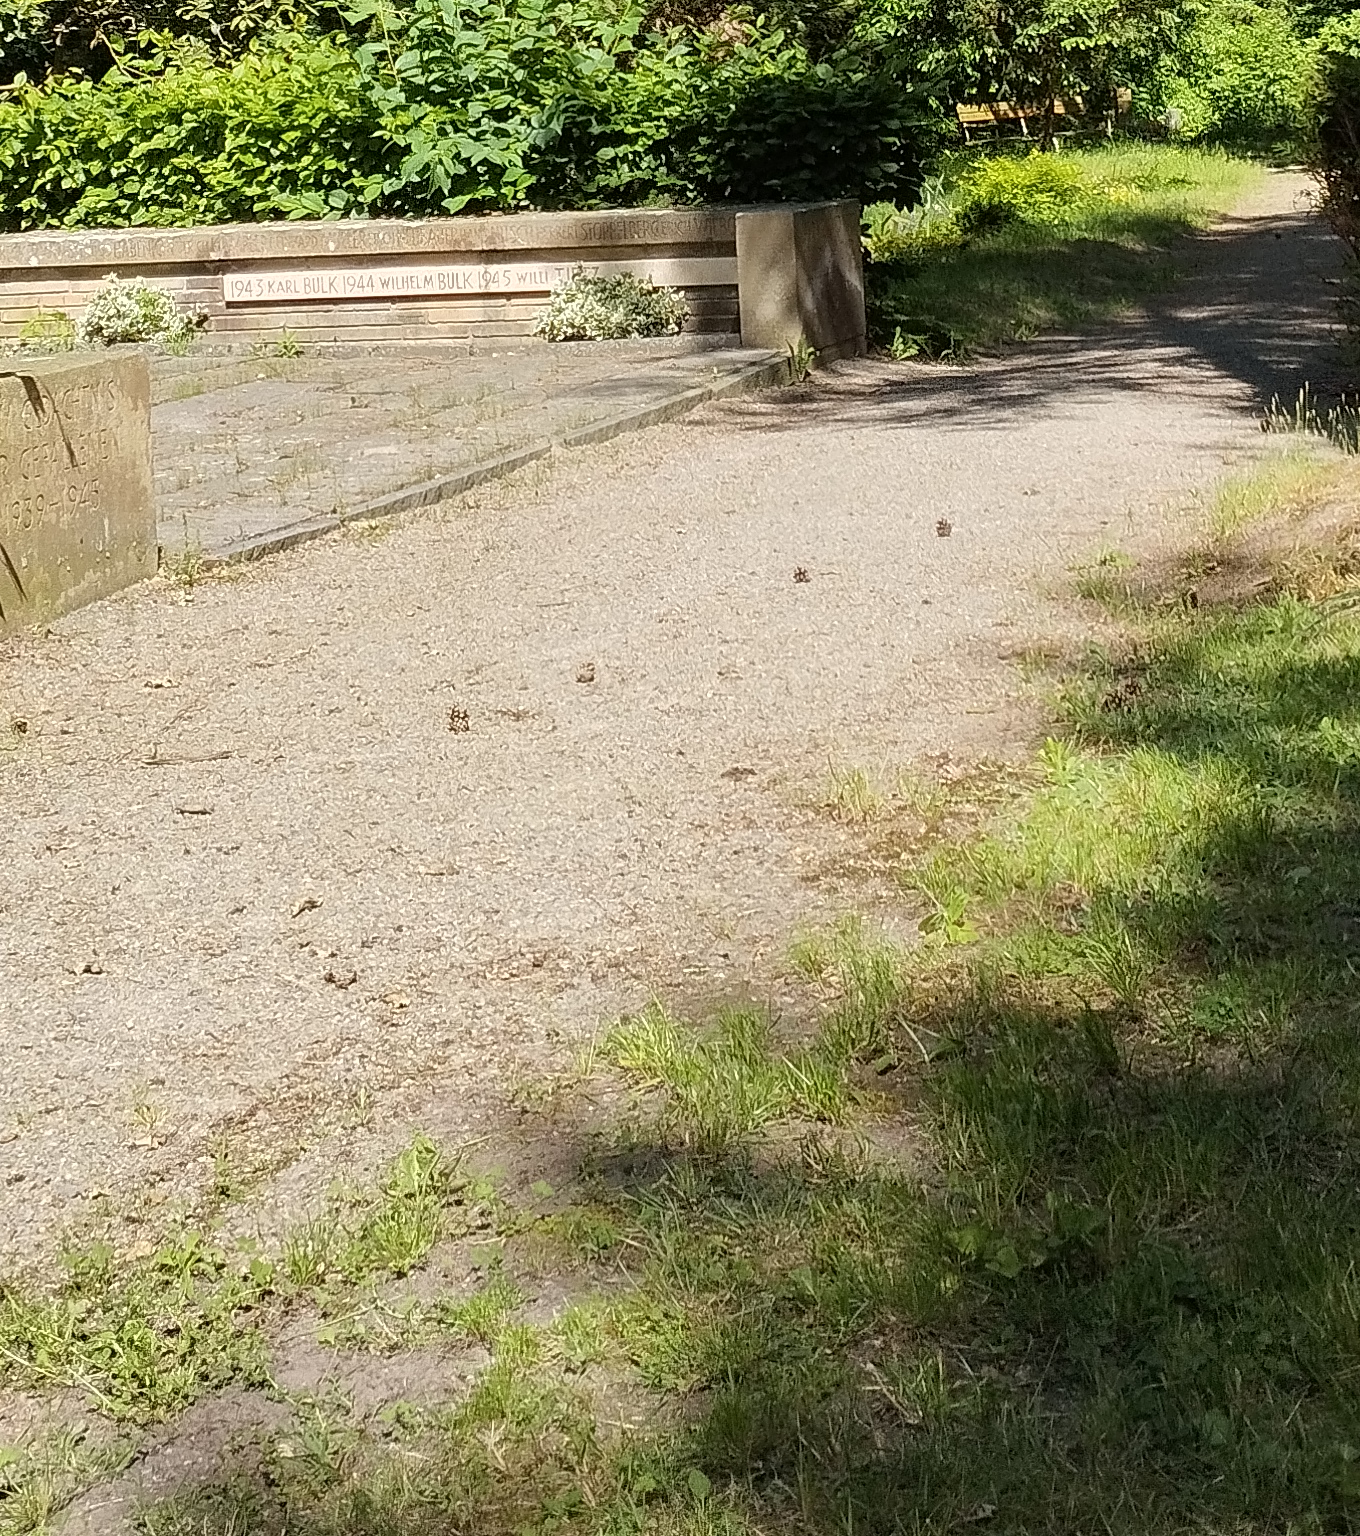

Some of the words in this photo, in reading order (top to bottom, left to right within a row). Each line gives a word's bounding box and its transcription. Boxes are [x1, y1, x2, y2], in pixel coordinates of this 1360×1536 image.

[231, 278, 264, 299] 1943
[267, 279, 301, 295] KARL
[303, 275, 339, 295] BULK
[343, 274, 375, 295] 1944
[379, 273, 434, 291] WILHELM
[438, 271, 473, 291] BULK
[478, 269, 512, 291] 1945
[516, 270, 549, 285] WILLI
